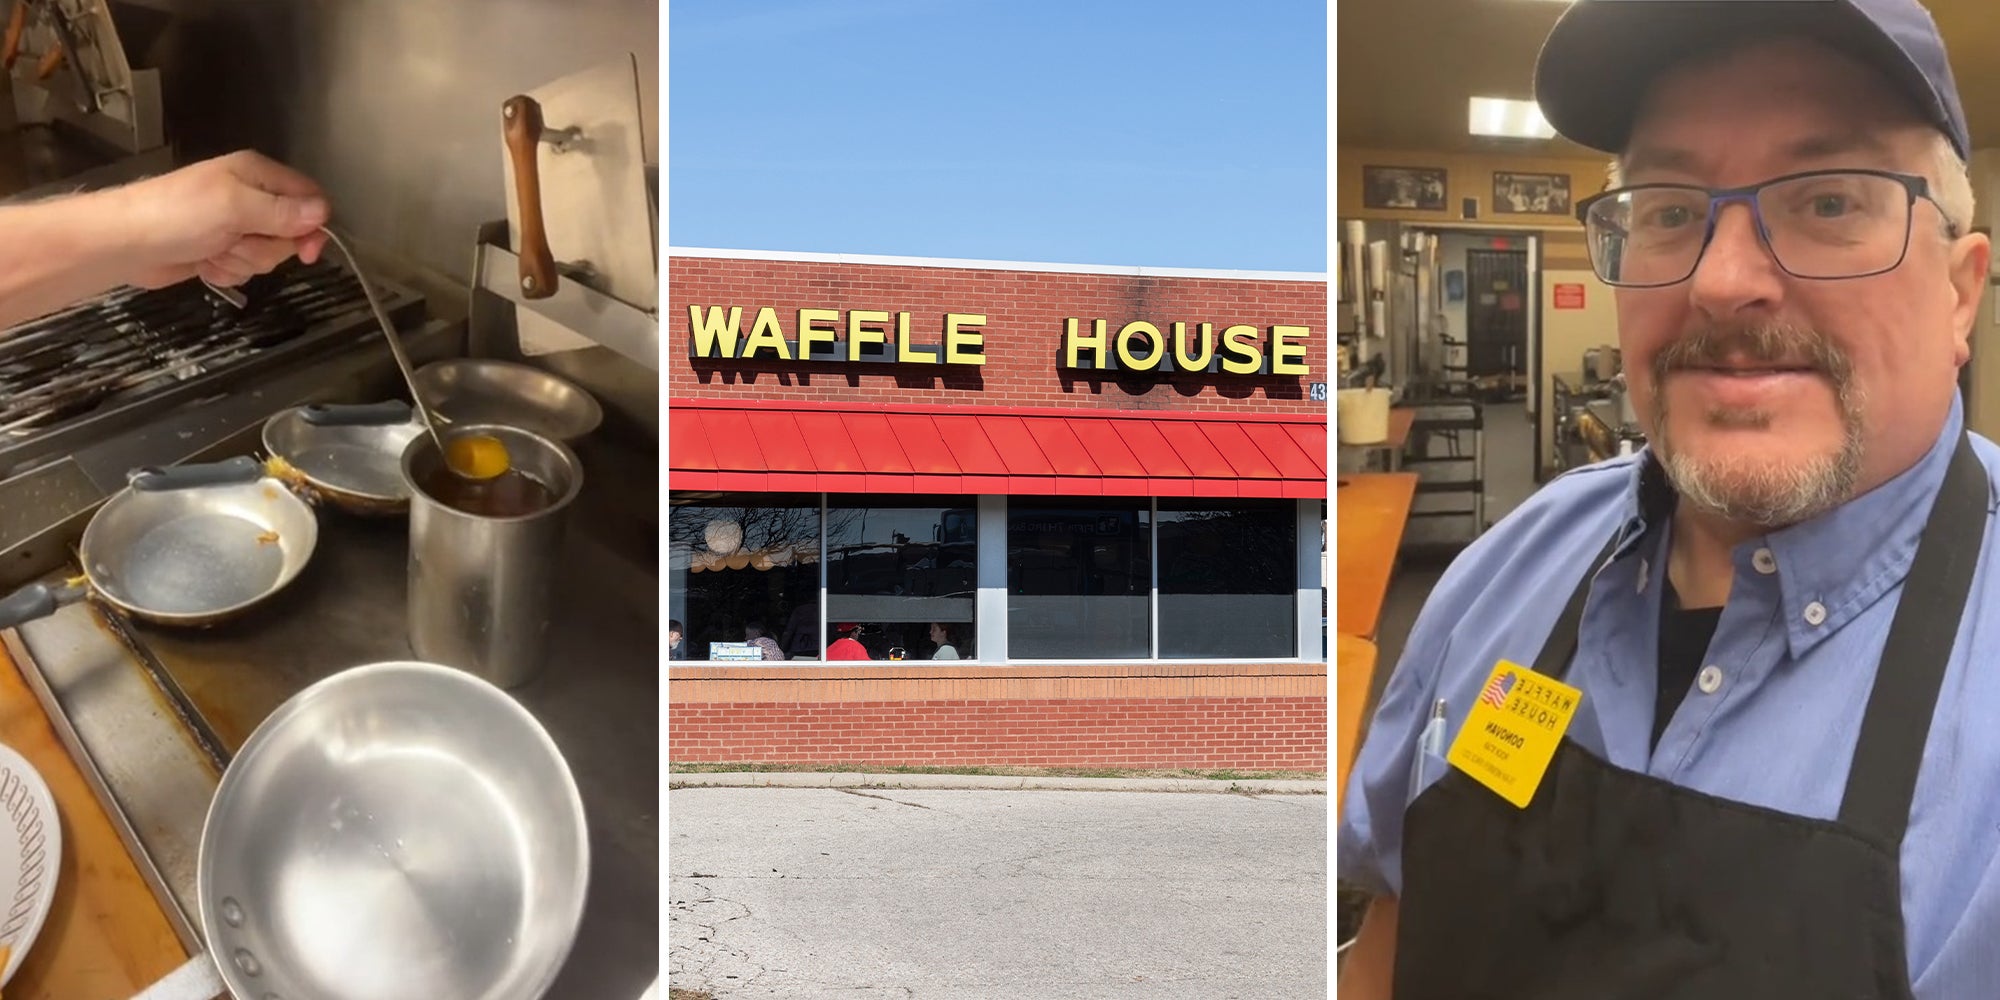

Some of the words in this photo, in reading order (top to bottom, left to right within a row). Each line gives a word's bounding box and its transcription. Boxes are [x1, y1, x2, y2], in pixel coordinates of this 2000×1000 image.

[688, 305, 987, 366] WAFFLE
[1066, 317, 1311, 376] HOUSE
[1310, 383, 1327, 401] 43
